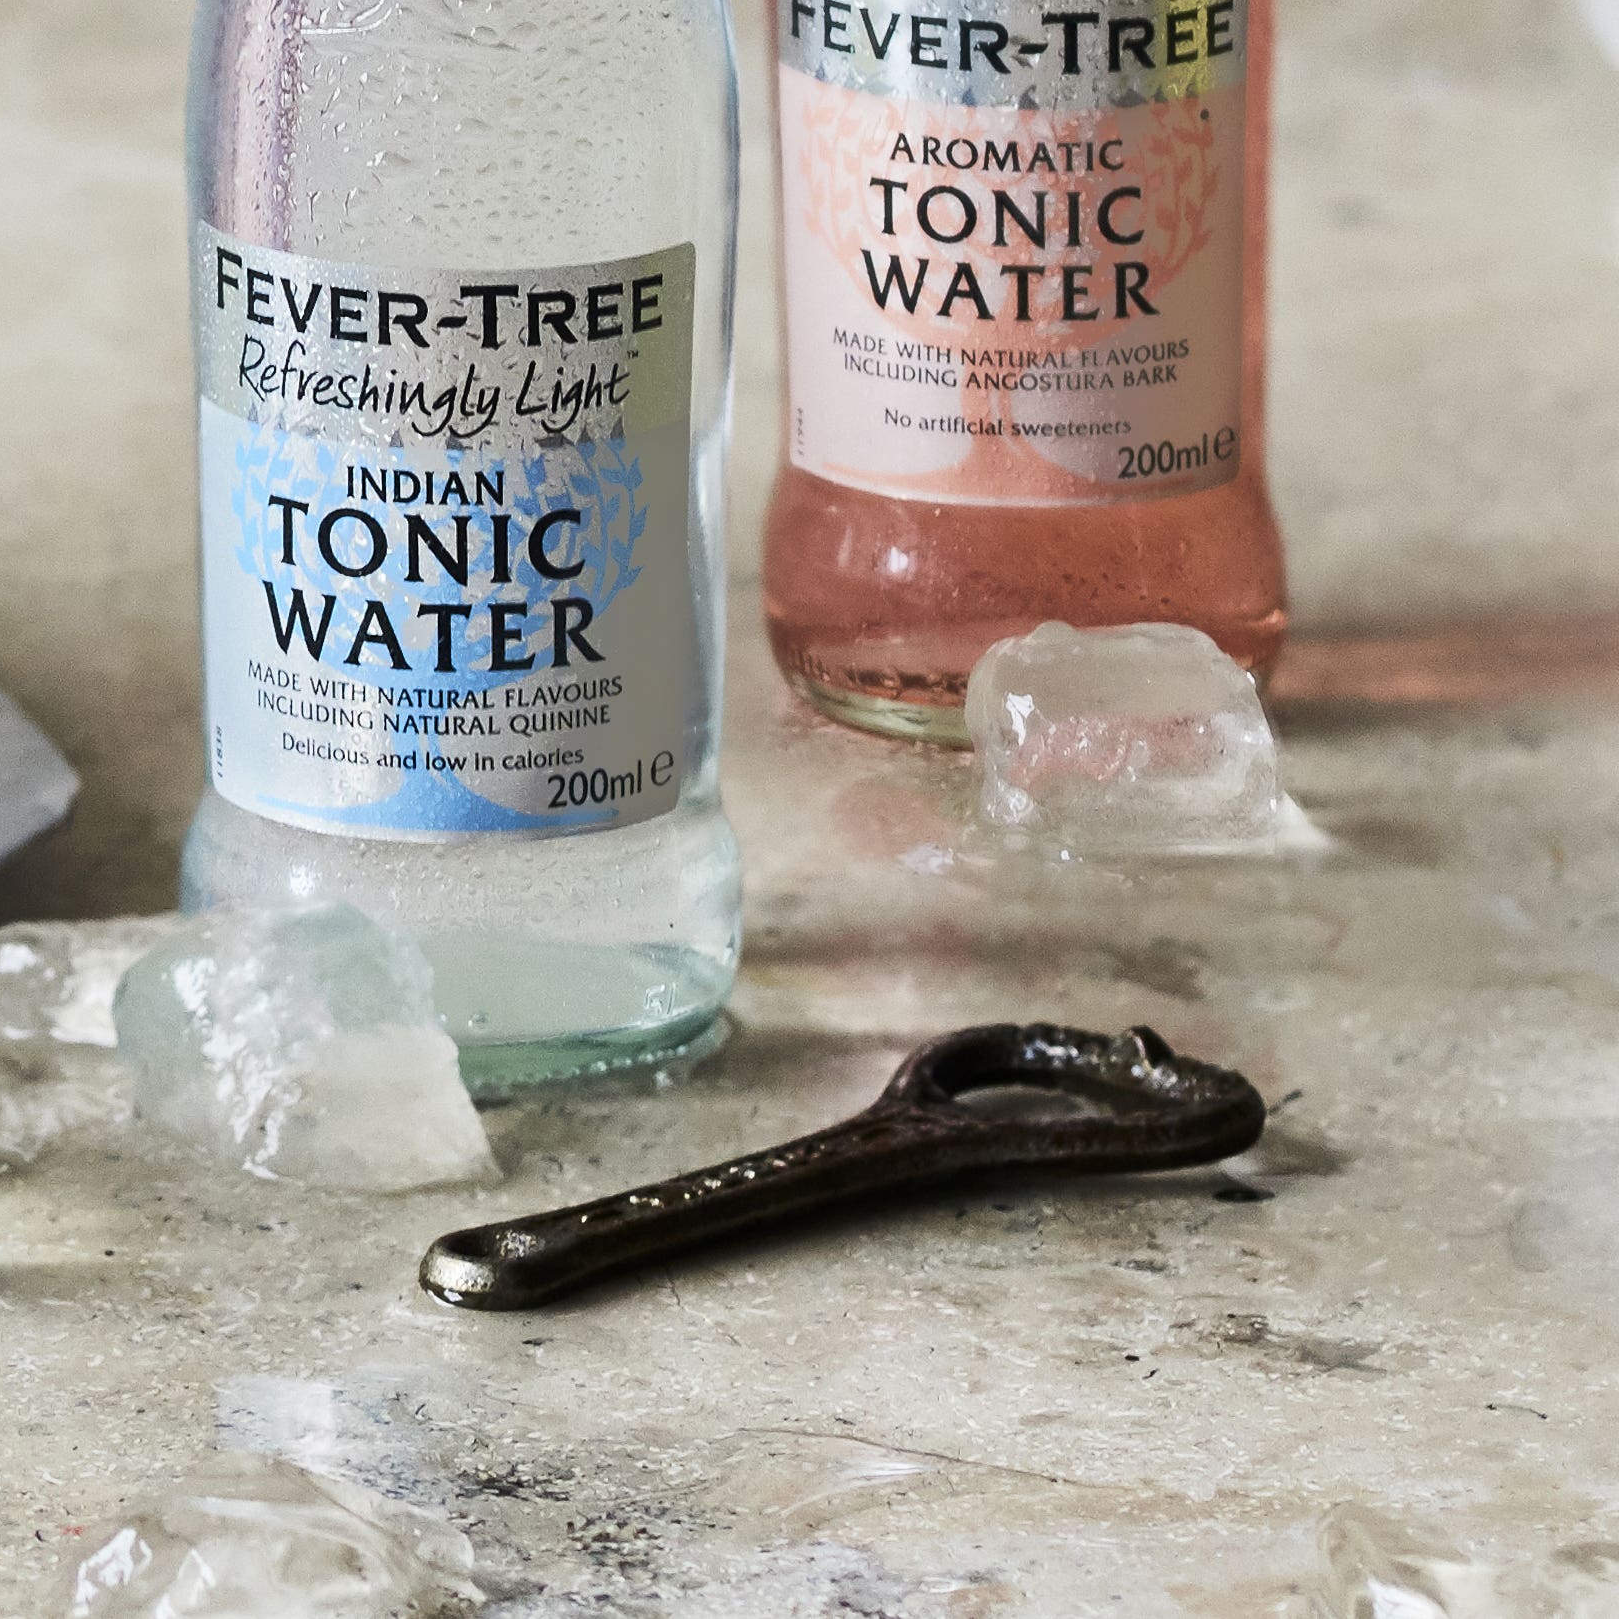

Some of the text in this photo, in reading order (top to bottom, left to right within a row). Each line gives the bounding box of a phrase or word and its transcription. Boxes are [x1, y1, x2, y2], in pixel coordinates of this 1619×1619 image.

[890, 132, 1125, 173] AROMATIC
[869, 178, 1144, 249] TONIC
[216, 247, 663, 350] FEVER-TREE
[860, 248, 1161, 321] WATER
[833, 327, 1190, 370] MADE WITH NATURAL FLAVOURS
[238, 334, 500, 438] Refreshingly
[844, 353, 1178, 392] INCLUDING ANGOSTURA BARK
[884, 409, 1132, 437] No artificial sweeteners
[1117, 435, 1208, 480] 200ml
[346, 466, 505, 507] INDIAN
[268, 495, 586, 586] TONIC
[262, 579, 606, 674] WATER
[248, 659, 623, 710] MADE WITH NATURAL FLAVOURS
[257, 689, 610, 737] INCLUDING NATURAL QUININE
[281, 732, 585, 771] Delicious and low in calories
[547, 768, 642, 809] 200ml
